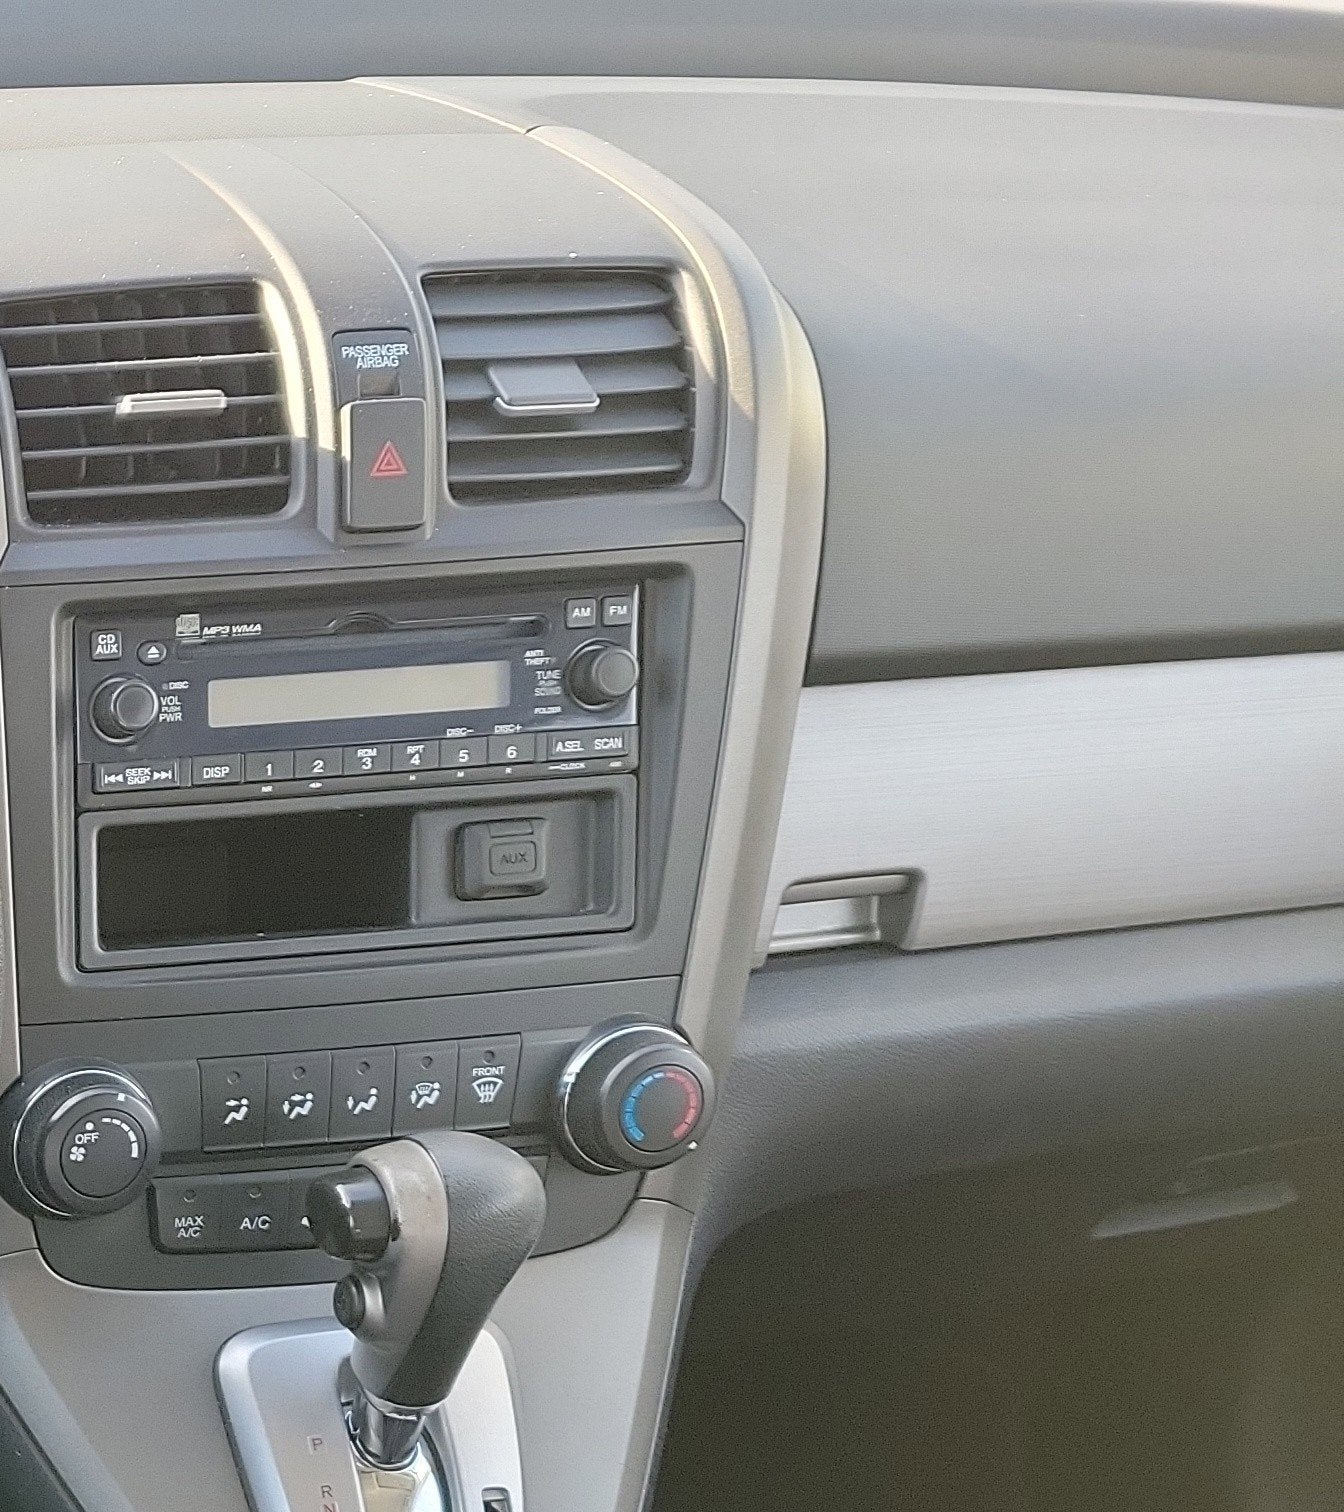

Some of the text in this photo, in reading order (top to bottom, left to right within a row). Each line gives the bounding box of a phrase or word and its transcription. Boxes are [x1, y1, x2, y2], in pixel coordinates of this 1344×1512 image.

[341, 343, 409, 358] PASSENGER
[356, 356, 399, 369] AIRBAG
[572, 607, 592, 618] AM
[609, 605, 628, 617] FM
[202, 623, 262, 636] MP3 WMA
[98, 634, 116, 644] CD
[95, 643, 119, 655] AUX
[160, 696, 182, 706] VOL
[159, 712, 183, 723] PWR
[406, 745, 425, 754] RPT
[594, 737, 623, 750] SCAN
[459, 749, 470, 763] 5
[507, 745, 518, 759] 6
[313, 759, 324, 773] 2
[361, 757, 372, 770] 3
[410, 753, 421, 766] 4
[125, 767, 152, 777] SEEK
[203, 766, 230, 779] DISP
[265, 763, 273, 776] 1
[127, 775, 151, 785] SKIP
[499, 852, 528, 866] AUX
[472, 1065, 506, 1077] FRONT
[75, 1132, 99, 1145] OFF
[174, 1215, 205, 1228] MAX
[240, 1215, 271, 1230] A/C
[177, 1227, 201, 1238] A/C
[312, 1437, 323, 1450] P
[321, 1485, 333, 1498] R
